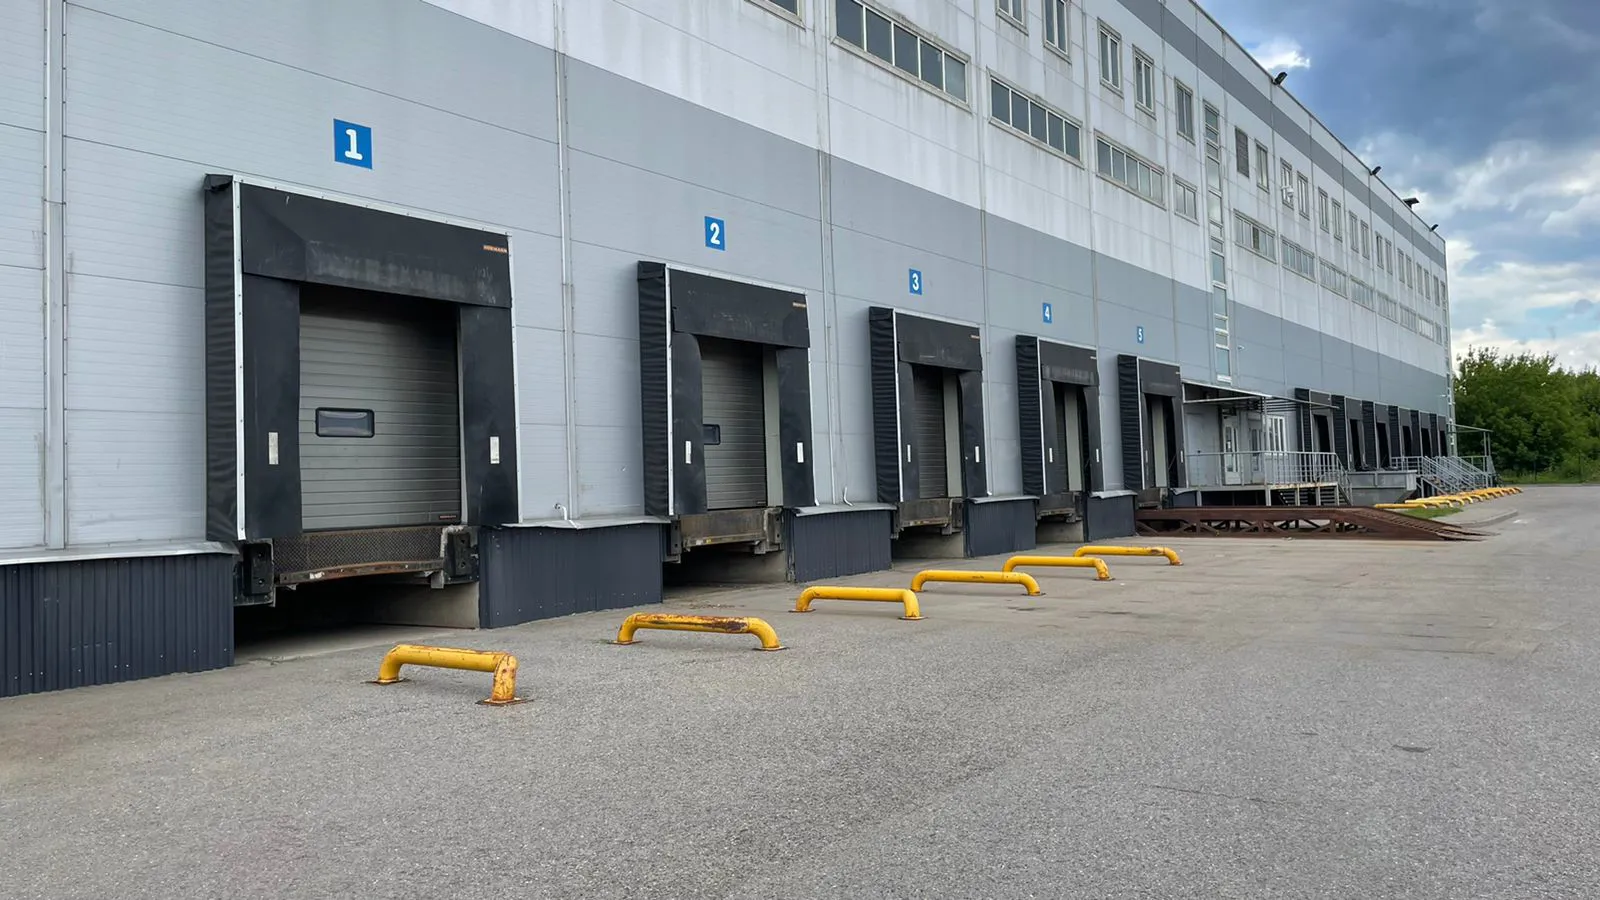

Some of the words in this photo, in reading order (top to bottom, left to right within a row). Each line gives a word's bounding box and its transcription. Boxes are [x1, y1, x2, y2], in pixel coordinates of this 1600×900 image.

[344, 128, 363, 160] 1
[710, 222, 721, 245] 2
[912, 272, 920, 291] 3
[1044, 305, 1050, 321] 4
